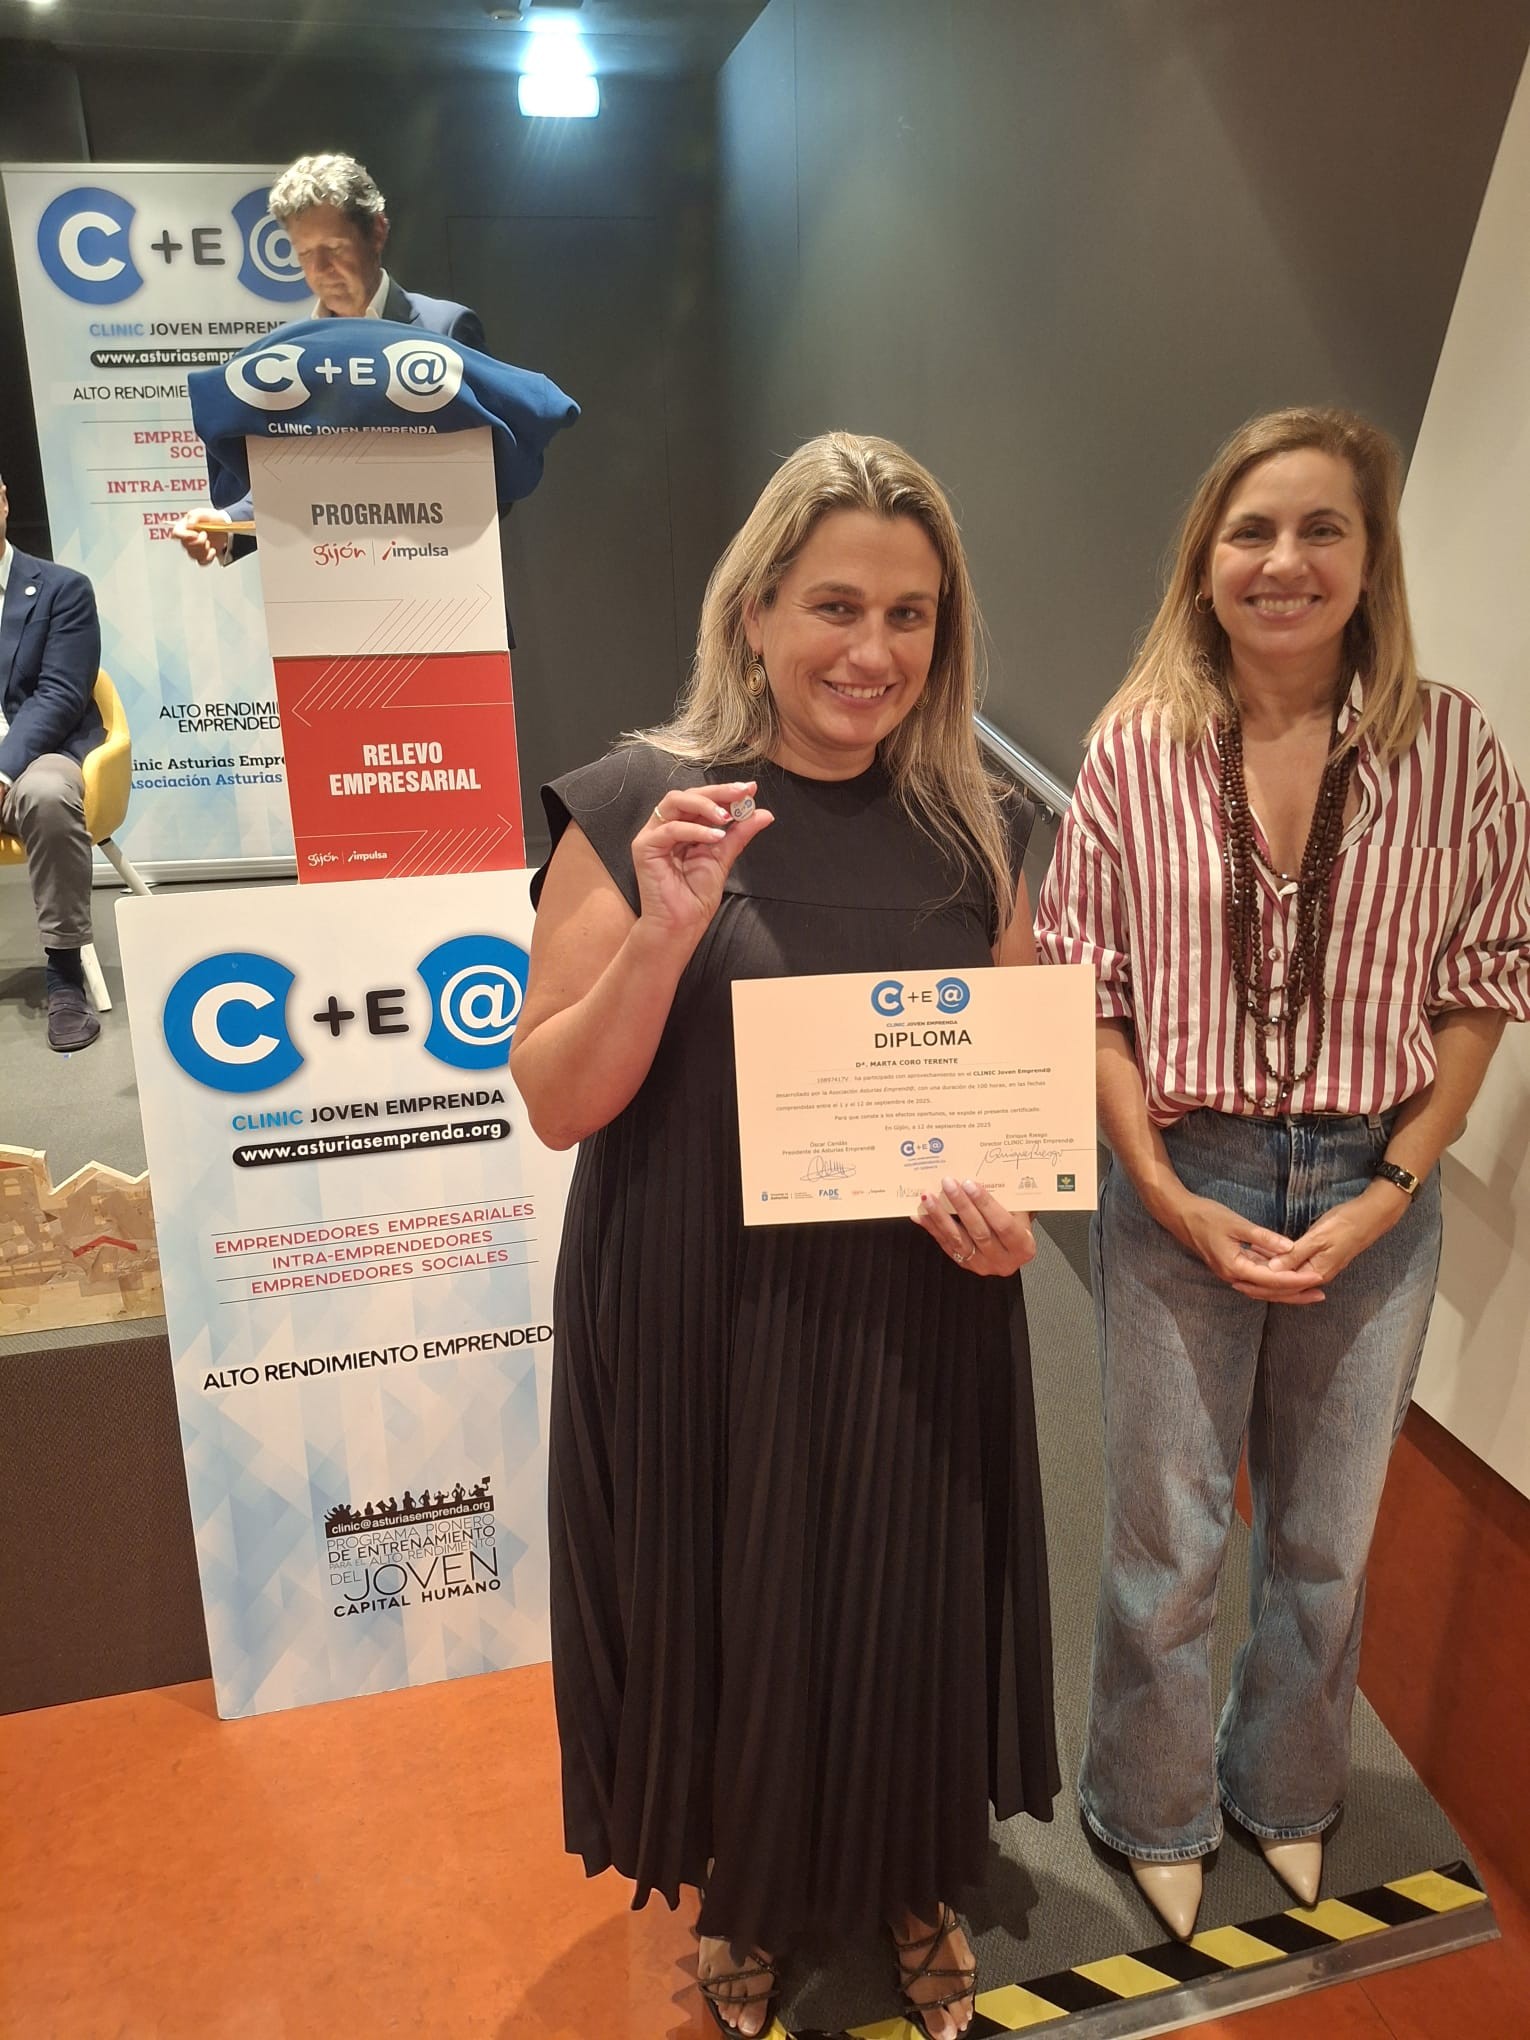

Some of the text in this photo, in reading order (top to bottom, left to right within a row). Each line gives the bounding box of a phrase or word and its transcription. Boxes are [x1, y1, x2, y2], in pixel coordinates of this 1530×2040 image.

[89, 321, 287, 337] CLINIC JOVEN EMPREN
[73, 385, 189, 401] ALTO RENDIMIE
[268, 422, 312, 435] CLINIC
[107, 479, 207, 493] INTRA-EMP
[143, 512, 188, 525] EMP
[311, 503, 443, 525] PROGRAMAS
[313, 541, 449, 566] gijón impulsa
[159, 704, 201, 719] ALTO
[178, 716, 281, 733] EMPRENDED
[131, 759, 163, 771] inic
[168, 756, 235, 770] Asturias
[362, 741, 443, 766] RELEVO
[215, 771, 283, 785] Asturias
[329, 768, 481, 796] EMPRESARIAL
[347, 851, 388, 862] impulsa
[874, 1029, 972, 1048] DIPLOMA
[232, 1089, 505, 1131] CLINIC JOVEN EMPRENDA
[240, 1122, 502, 1162] www.asturiasemprenda.org
[818, 1188, 839, 1197] FADE
[215, 1203, 535, 1255] EMPRENDEDORES EMPRESARIALES
[272, 1230, 493, 1269] INTRA-EMPRENDEDORES
[251, 1249, 509, 1295] EMPRENDEDORES SOCIALES
[203, 1325, 554, 1390] ALTO RENDIMIENTO EMPRENDED
[331, 1501, 491, 1535] clinic@asturiasemprenda.org
[327, 1513, 495, 1551] PROGRAMA PIONERO
[328, 1525, 496, 1564] DE ENTRENAMIENTO
[329, 1561, 352, 1570] PARA
[369, 1552, 403, 1567] ALTO
[408, 1536, 496, 1561] RENDIMIENTO
[330, 1546, 499, 1601] DEL JOVEN
[333, 1578, 501, 1618] CAPITAL HUMANO
